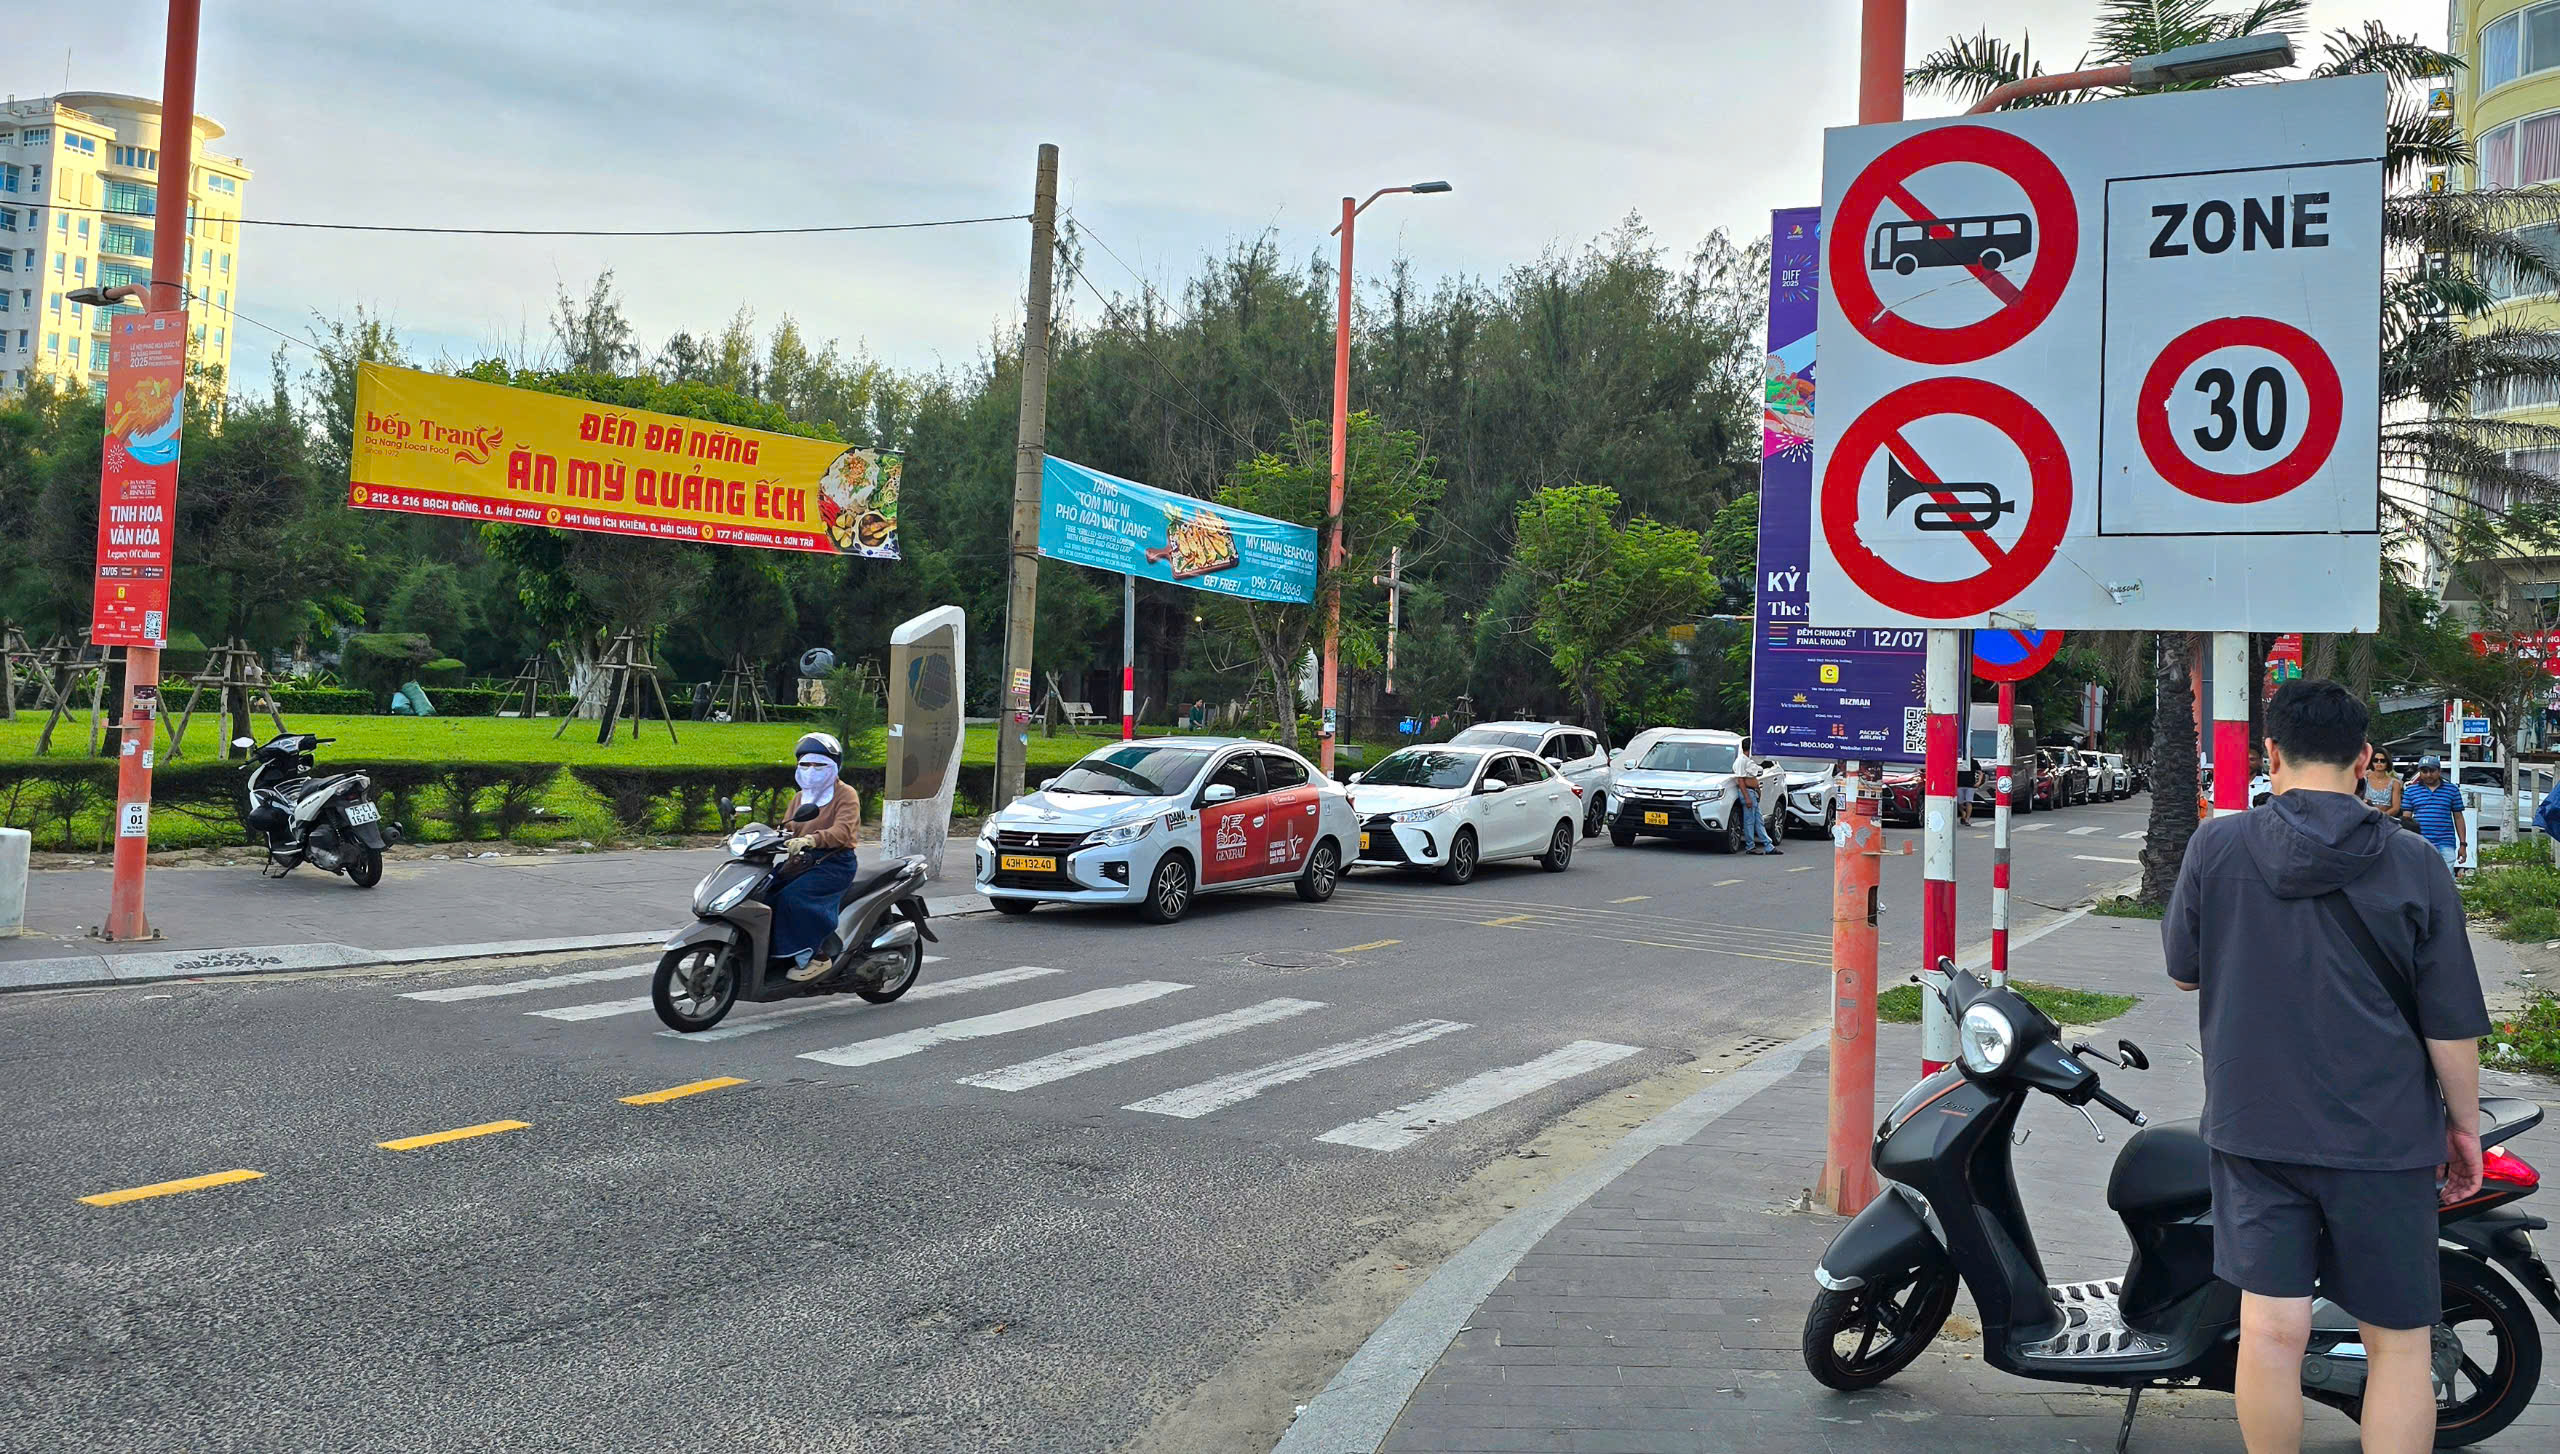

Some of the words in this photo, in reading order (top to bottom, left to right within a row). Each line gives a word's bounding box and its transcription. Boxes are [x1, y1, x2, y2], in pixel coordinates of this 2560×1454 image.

[2149, 191, 2330, 259] ZONE
[1782, 269, 1801, 281] DIFF
[130, 356, 149, 368] 2025
[2193, 365, 2287, 452] 30
[366, 410, 411, 440] bếp
[365, 436, 378, 445] Da
[380, 438, 402, 450] Nang
[404, 441, 428, 452] Local
[429, 445, 450, 455] Food
[579, 411, 638, 448] ĐẾN
[644, 423, 684, 454] ĐÀ
[688, 429, 760, 466] NẴNG
[385, 449, 400, 457] 1972
[507, 443, 557, 494] ĂN
[566, 458, 627, 502] MỲ
[634, 464, 746, 517] QUẢNG
[754, 477, 806, 523] ẾCH
[110, 506, 137, 522] TINH
[138, 506, 163, 522] HOA
[371, 492, 389, 504] 212
[392, 495, 400, 505] &
[402, 496, 420, 507] 216
[423, 497, 449, 512] BẠCH
[484, 504, 494, 516] Q.
[516, 507, 542, 520] CHÂU
[1120, 503, 1131, 518] NI
[1055, 503, 1078, 521] PHÔ
[1078, 510, 1100, 528] MAI
[564, 514, 581, 524] 441
[583, 514, 601, 527] ÔNG
[650, 522, 659, 533] Q.
[676, 524, 698, 537] CHÂU
[110, 525, 134, 545] VĂN
[136, 525, 160, 545] HÓA
[716, 530, 731, 540] 177
[775, 535, 783, 544] Q.
[784, 535, 798, 546] SƠN
[799, 536, 814, 548] TRÀ
[107, 549, 128, 560] Legacy
[129, 549, 137, 558] Of
[137, 550, 160, 558] Culture
[1283, 544, 1314, 563] SEAFOOD
[101, 567, 118, 576] 31/05
[1767, 565, 1801, 592] KỶ
[1203, 575, 1220, 588] GET
[1220, 578, 1242, 592] FREE!
[1251, 576, 1267, 590] 096
[1268, 578, 1282, 592] 774
[1282, 582, 1302, 596] 8668
[1767, 601, 1801, 616] The
[1796, 628, 1814, 637] ĐÊM
[1814, 630, 1840, 638] CHUNG
[1841, 628, 1857, 638] KẾT
[1872, 630, 1924, 648] 12/07
[1796, 638, 1820, 646] FINAL
[1820, 638, 1846, 646] ROUND
[1839, 698, 1870, 706] BIZMAN
[1766, 726, 1788, 734] ACV
[1800, 741, 1834, 750] 1800.1000
[350, 804, 372, 816] 75-C1
[1169, 810, 1186, 824] DANA
[130, 814, 143, 825] 01
[1216, 846, 1246, 862] GENERALI
[1006, 858, 1051, 870] 43H-132.40
